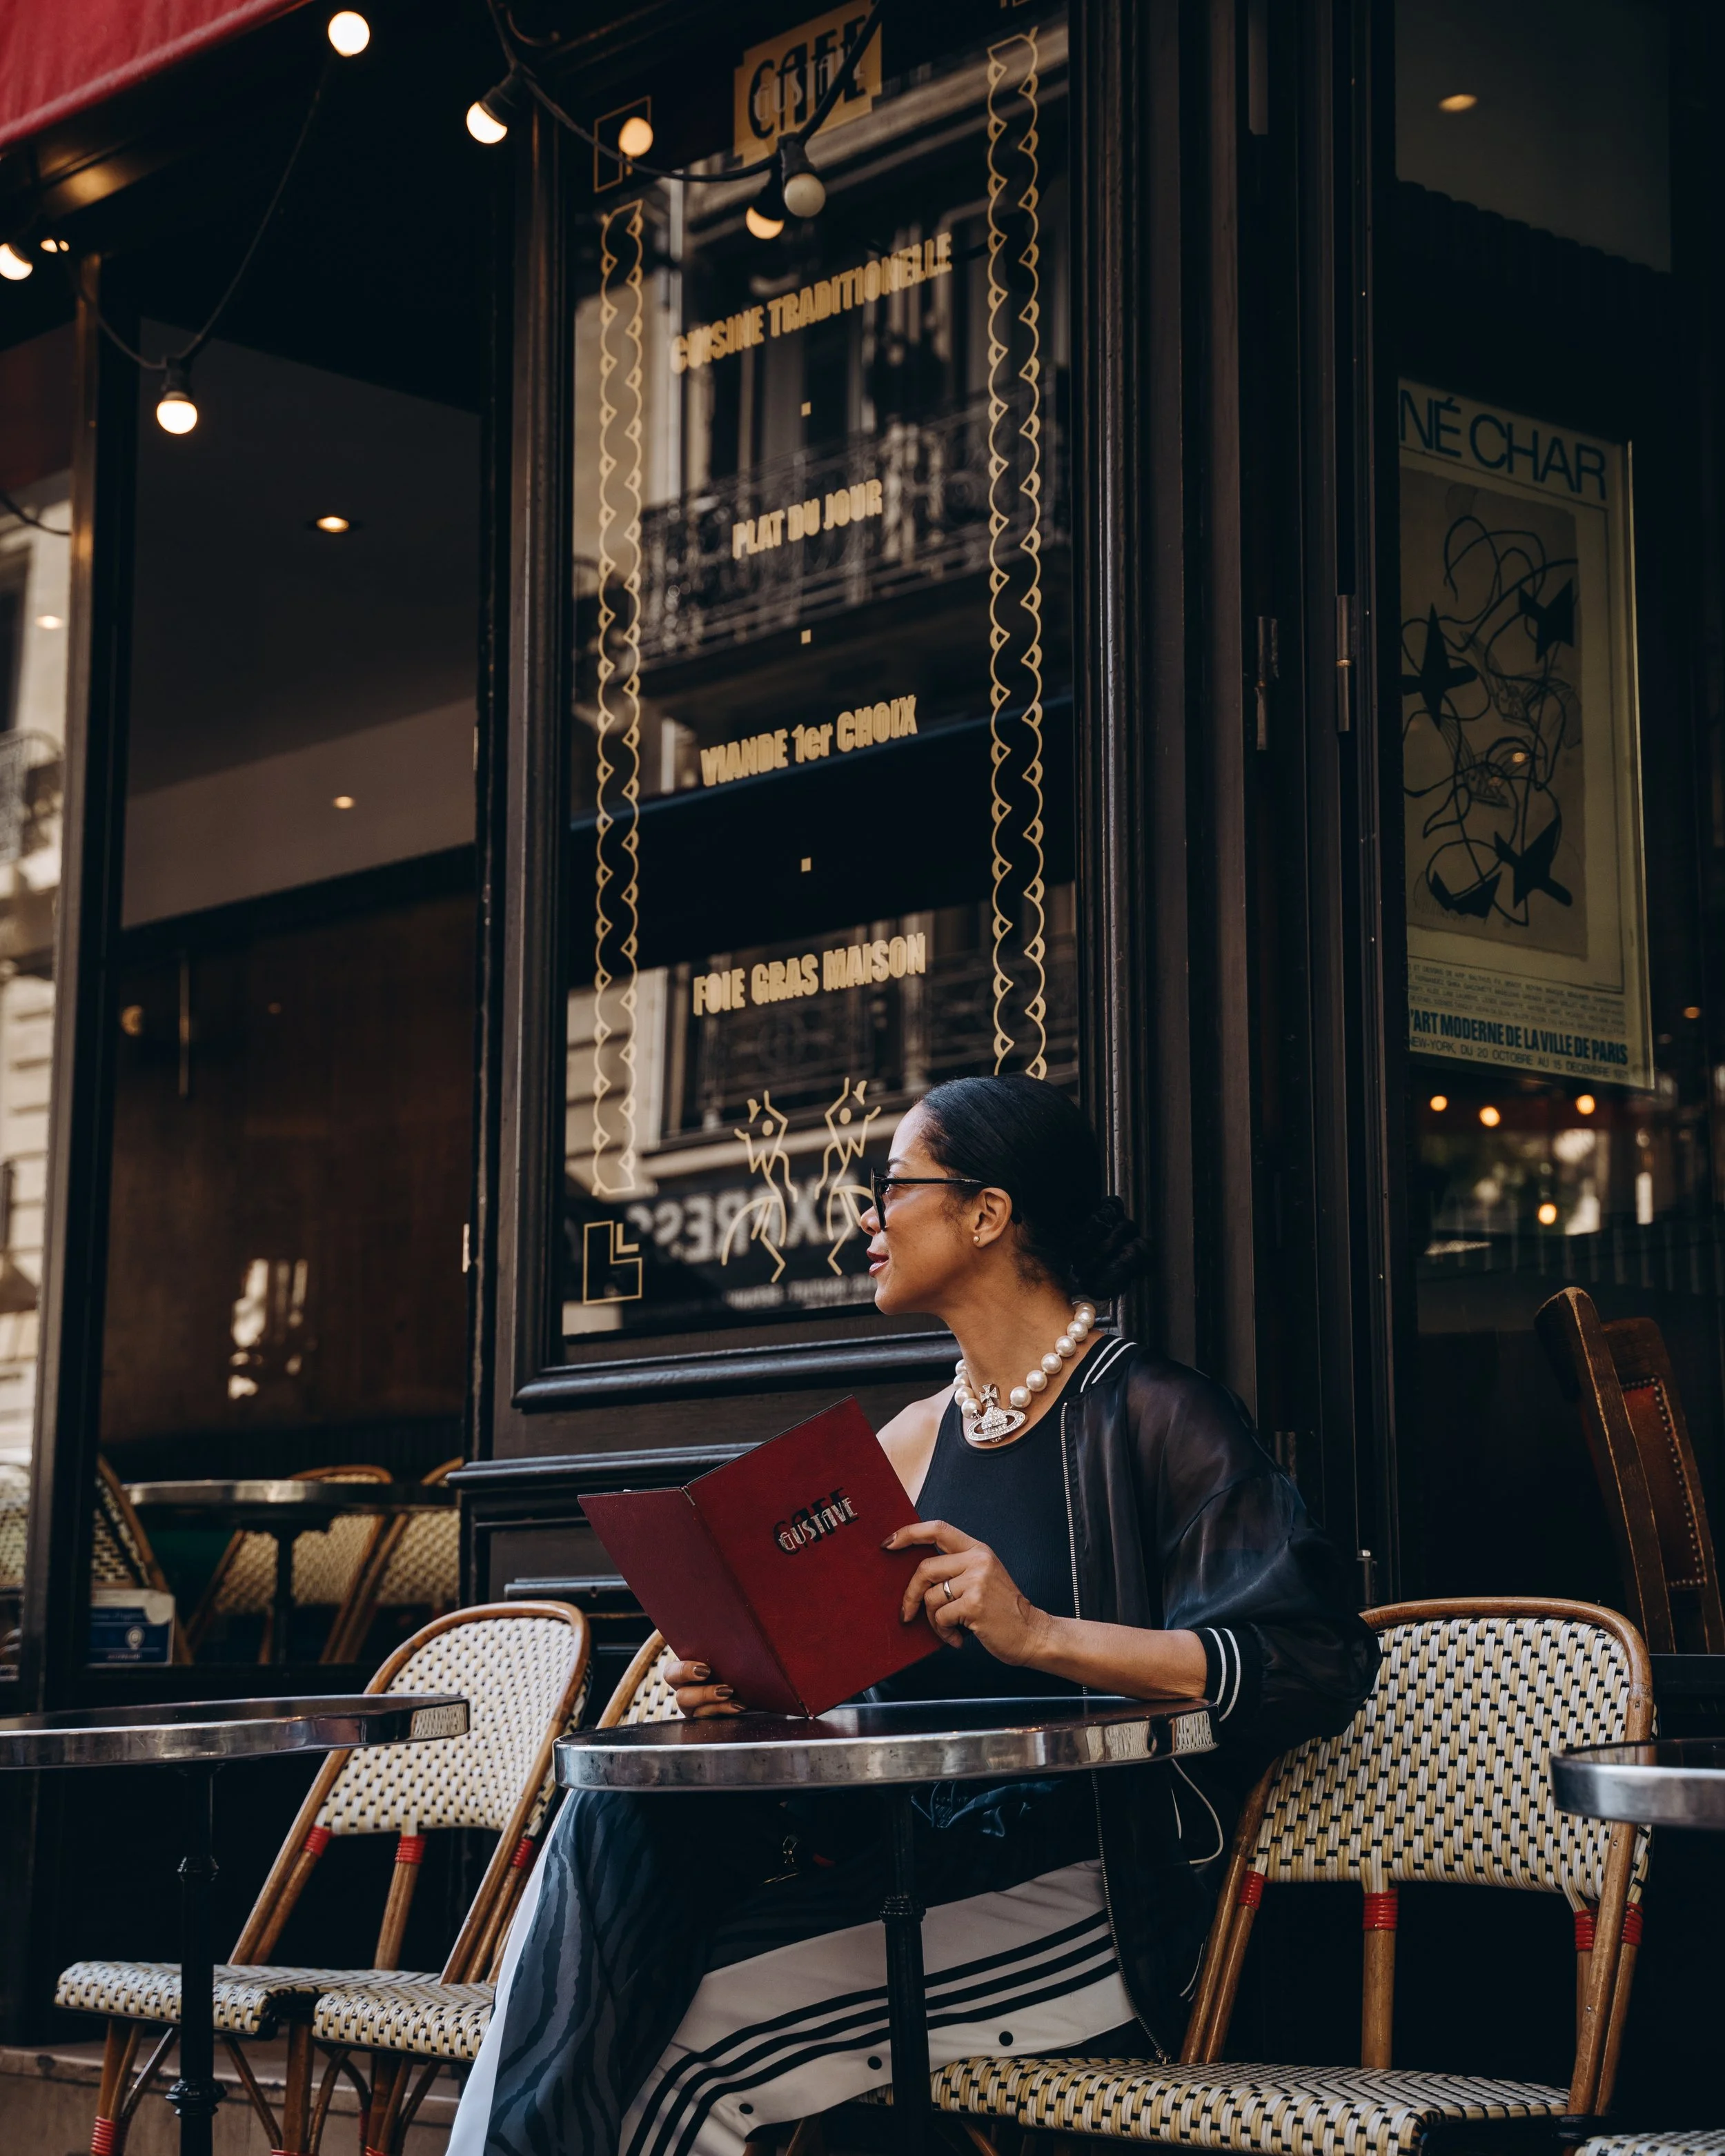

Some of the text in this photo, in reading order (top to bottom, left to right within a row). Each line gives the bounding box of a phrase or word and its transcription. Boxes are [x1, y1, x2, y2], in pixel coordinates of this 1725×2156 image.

[671, 233, 953, 375] CUISINE TRADITIONELLE
[1399, 389, 1606, 501] NÉ CHAR
[732, 479, 883, 559] PLAT DU JOUR
[700, 694, 918, 787] VIANDE 1er CHOIX
[693, 932, 926, 1016] FOIE GRAS MAISON
[1441, 1013, 1504, 1046] MODERNE
[1506, 1025, 1522, 1049] DE
[1524, 1029, 1539, 1051] LA
[1540, 1030, 1573, 1056] VILLE
[1575, 1036, 1590, 1059] DE
[1592, 1039, 1628, 1065] PARIS
[1461, 1043, 1474, 1057] DU
[1477, 1047, 1489, 1059] 20
[1492, 1048, 1533, 1066] OCTOBRE
[1538, 1056, 1550, 1068] AU
[779, 1497, 858, 1551] GUSTAVE
